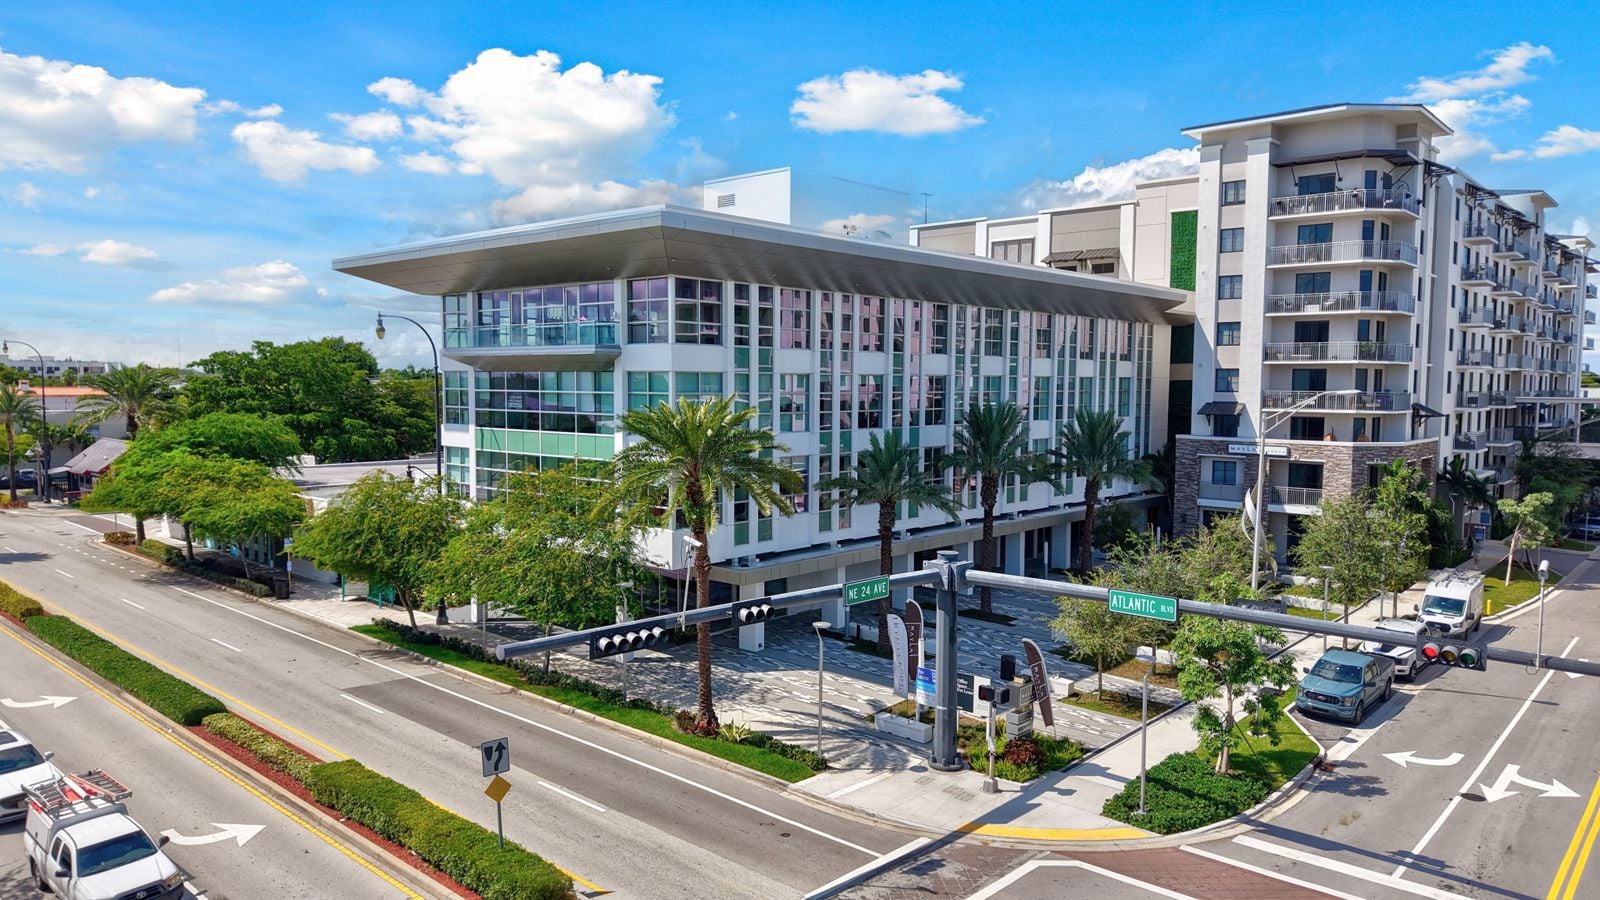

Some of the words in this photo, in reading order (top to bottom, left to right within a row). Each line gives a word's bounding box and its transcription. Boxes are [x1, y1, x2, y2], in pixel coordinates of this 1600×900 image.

[849, 588, 858, 600] NE
[861, 585, 870, 597] 24
[873, 582, 887, 595] AVE
[1111, 594, 1156, 613] ATLANTIC
[1160, 604, 1174, 614] BLVD
